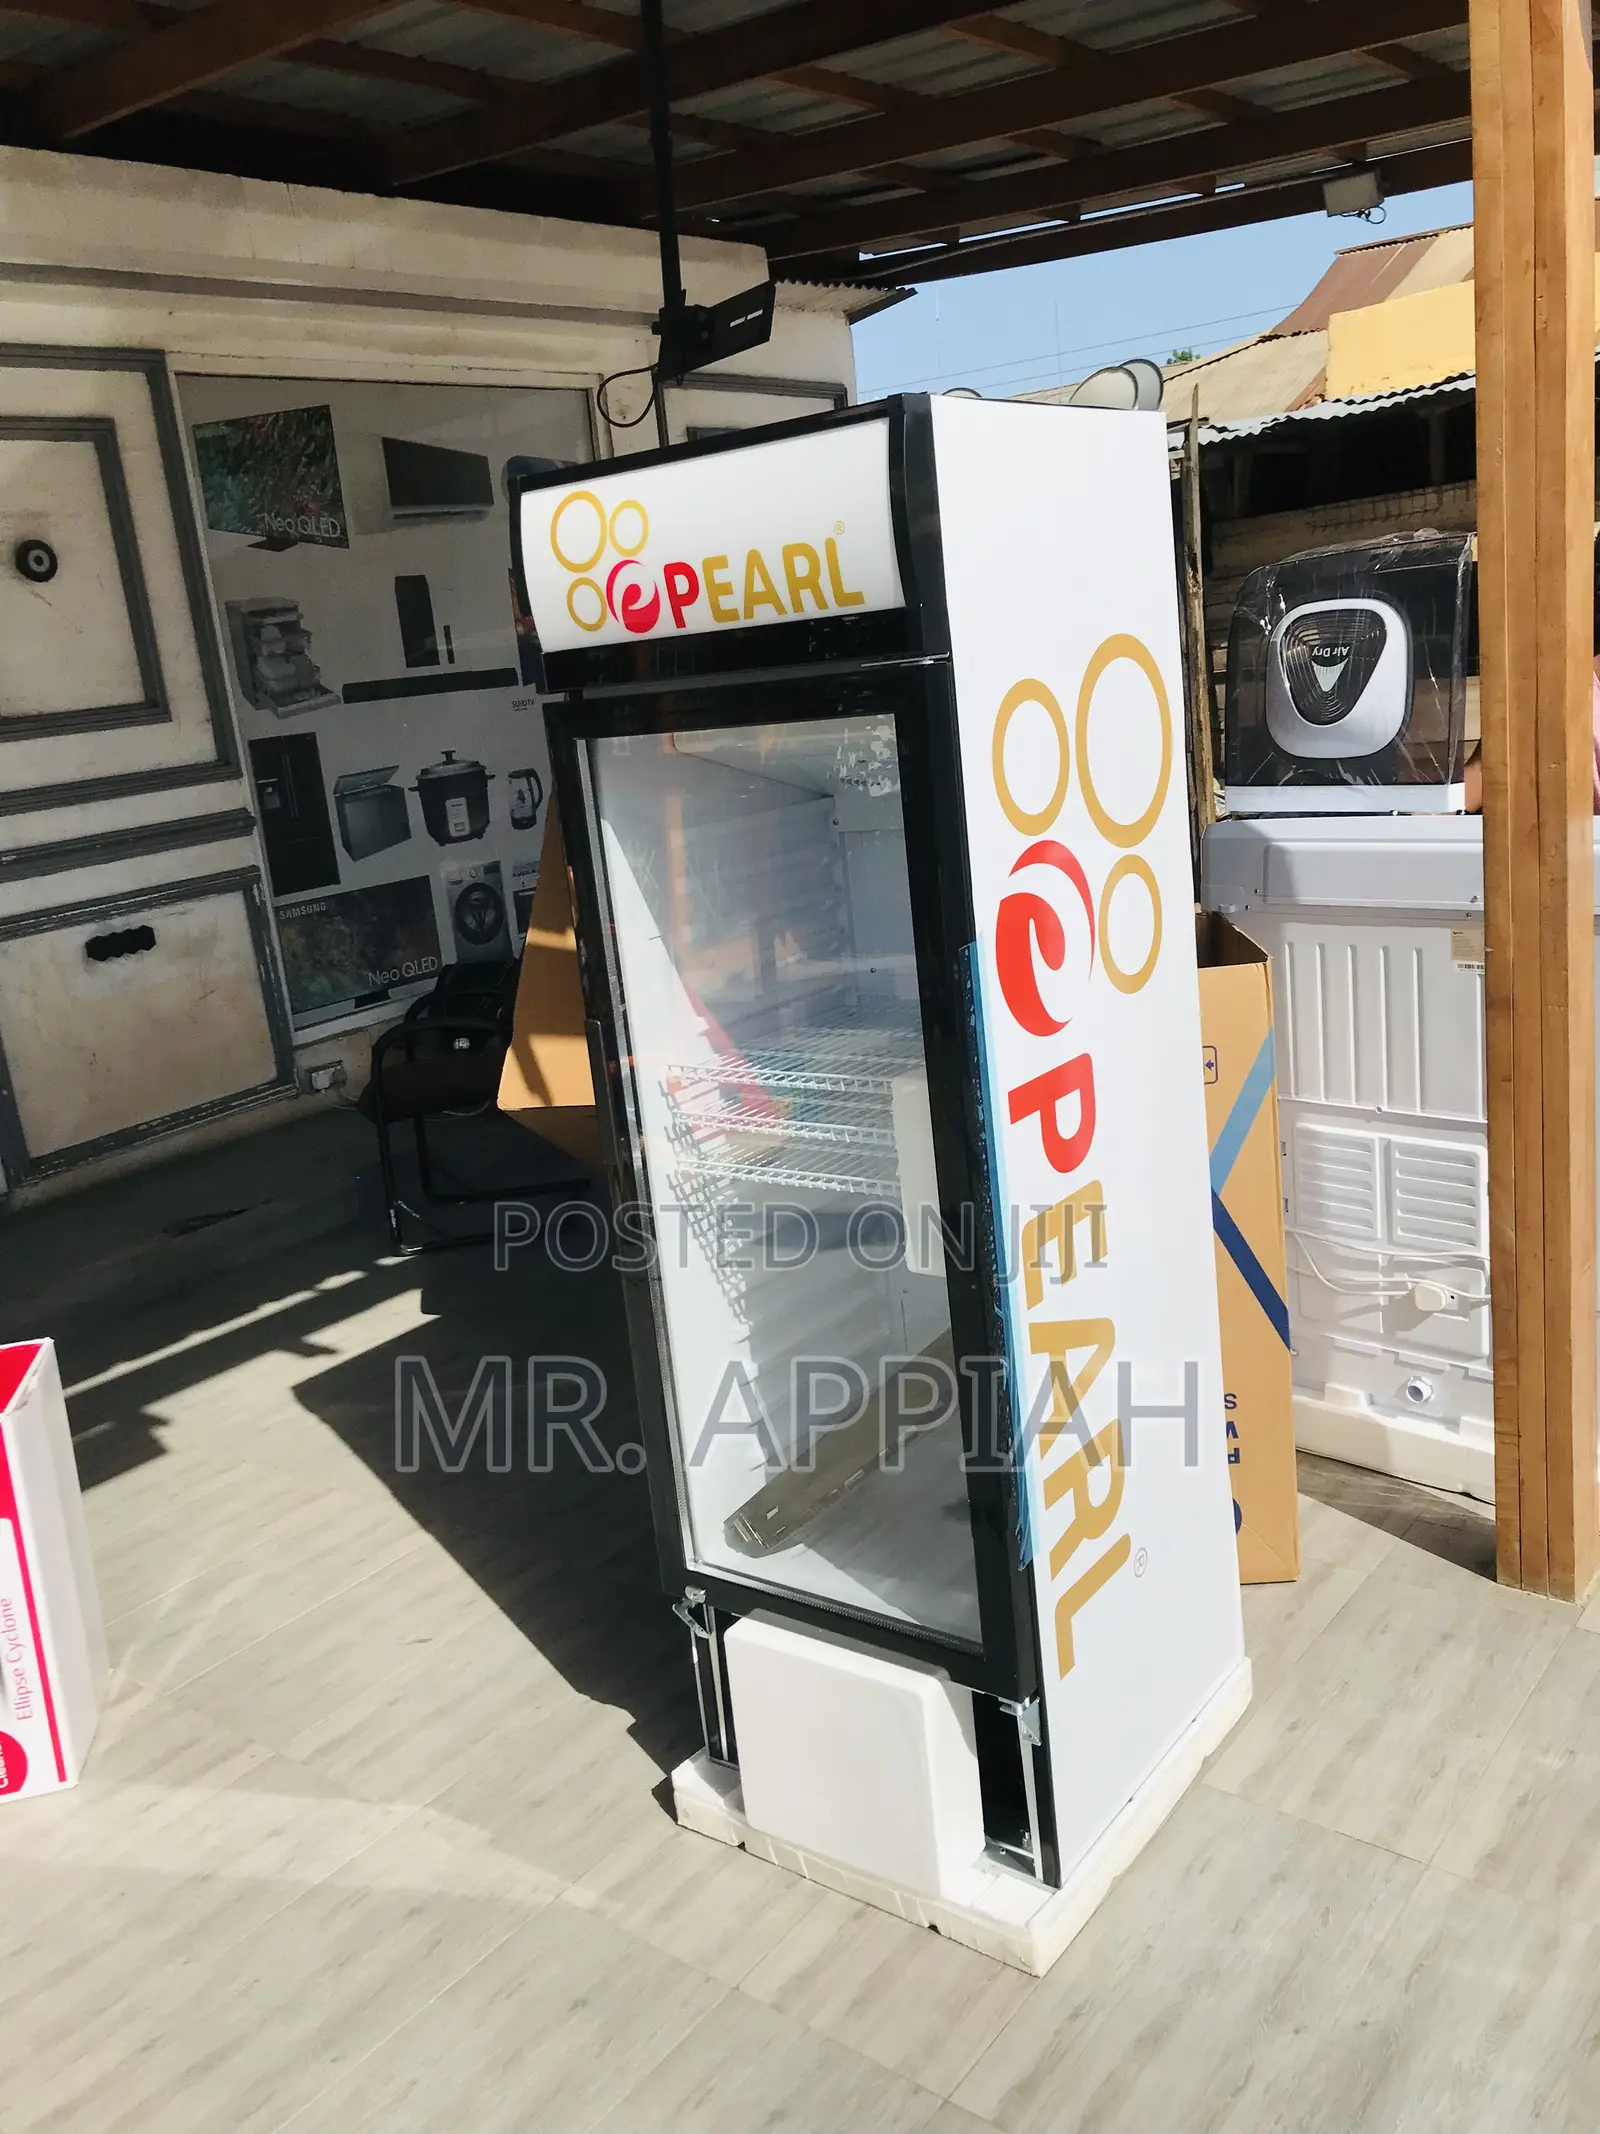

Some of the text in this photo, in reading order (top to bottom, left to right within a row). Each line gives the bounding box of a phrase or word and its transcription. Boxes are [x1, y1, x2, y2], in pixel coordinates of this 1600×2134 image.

[264, 513, 341, 537] Neo QLED
[664, 537, 865, 629] PEARL
[1311, 646, 1350, 658] Air Dry
[279, 902, 327, 920] SAMSUNG
[367, 956, 438, 987] Neo QLED
[1008, 1052, 1132, 1681] PEARL
[0, 1598, 33, 1720] Ellipse Cyclone
